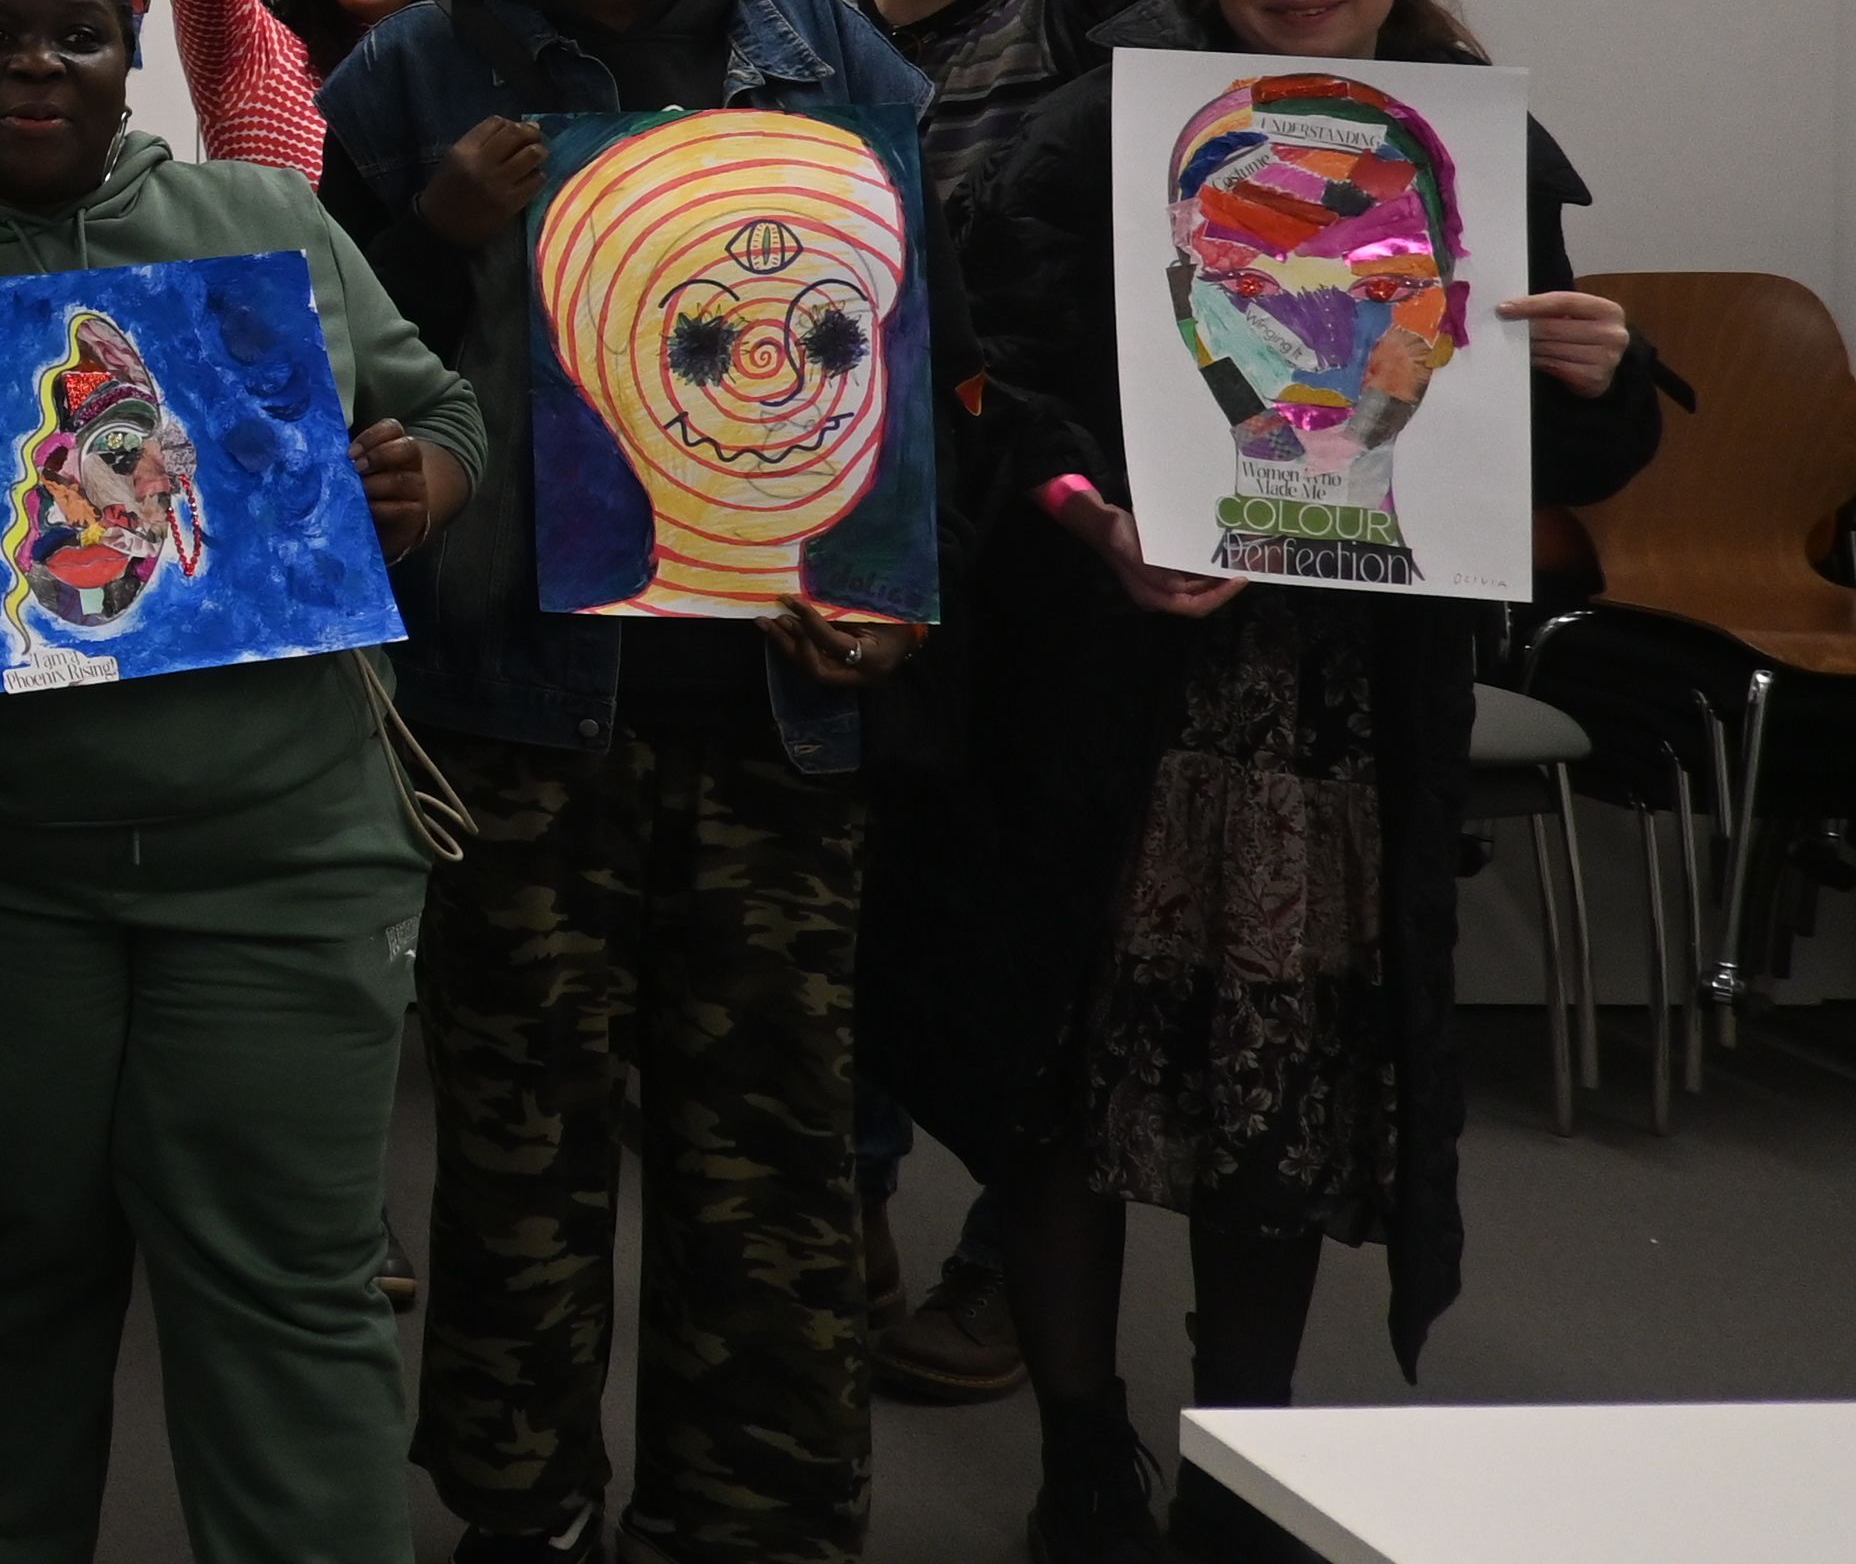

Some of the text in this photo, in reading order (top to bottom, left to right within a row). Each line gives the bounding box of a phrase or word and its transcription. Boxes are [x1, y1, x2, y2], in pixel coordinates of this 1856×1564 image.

[1260, 116, 1381, 149] UNDERSTANDING
[1212, 152, 1271, 188] Costume
[1246, 309, 1293, 355] Winging
[1241, 461, 1300, 483] Women
[1255, 478, 1327, 501] Made Me
[1216, 494, 1394, 544] COLOUR
[1223, 530, 1411, 585] Perfection
[5, 657, 117, 690] Phoenix Rising!
[43, 652, 68, 670] am
